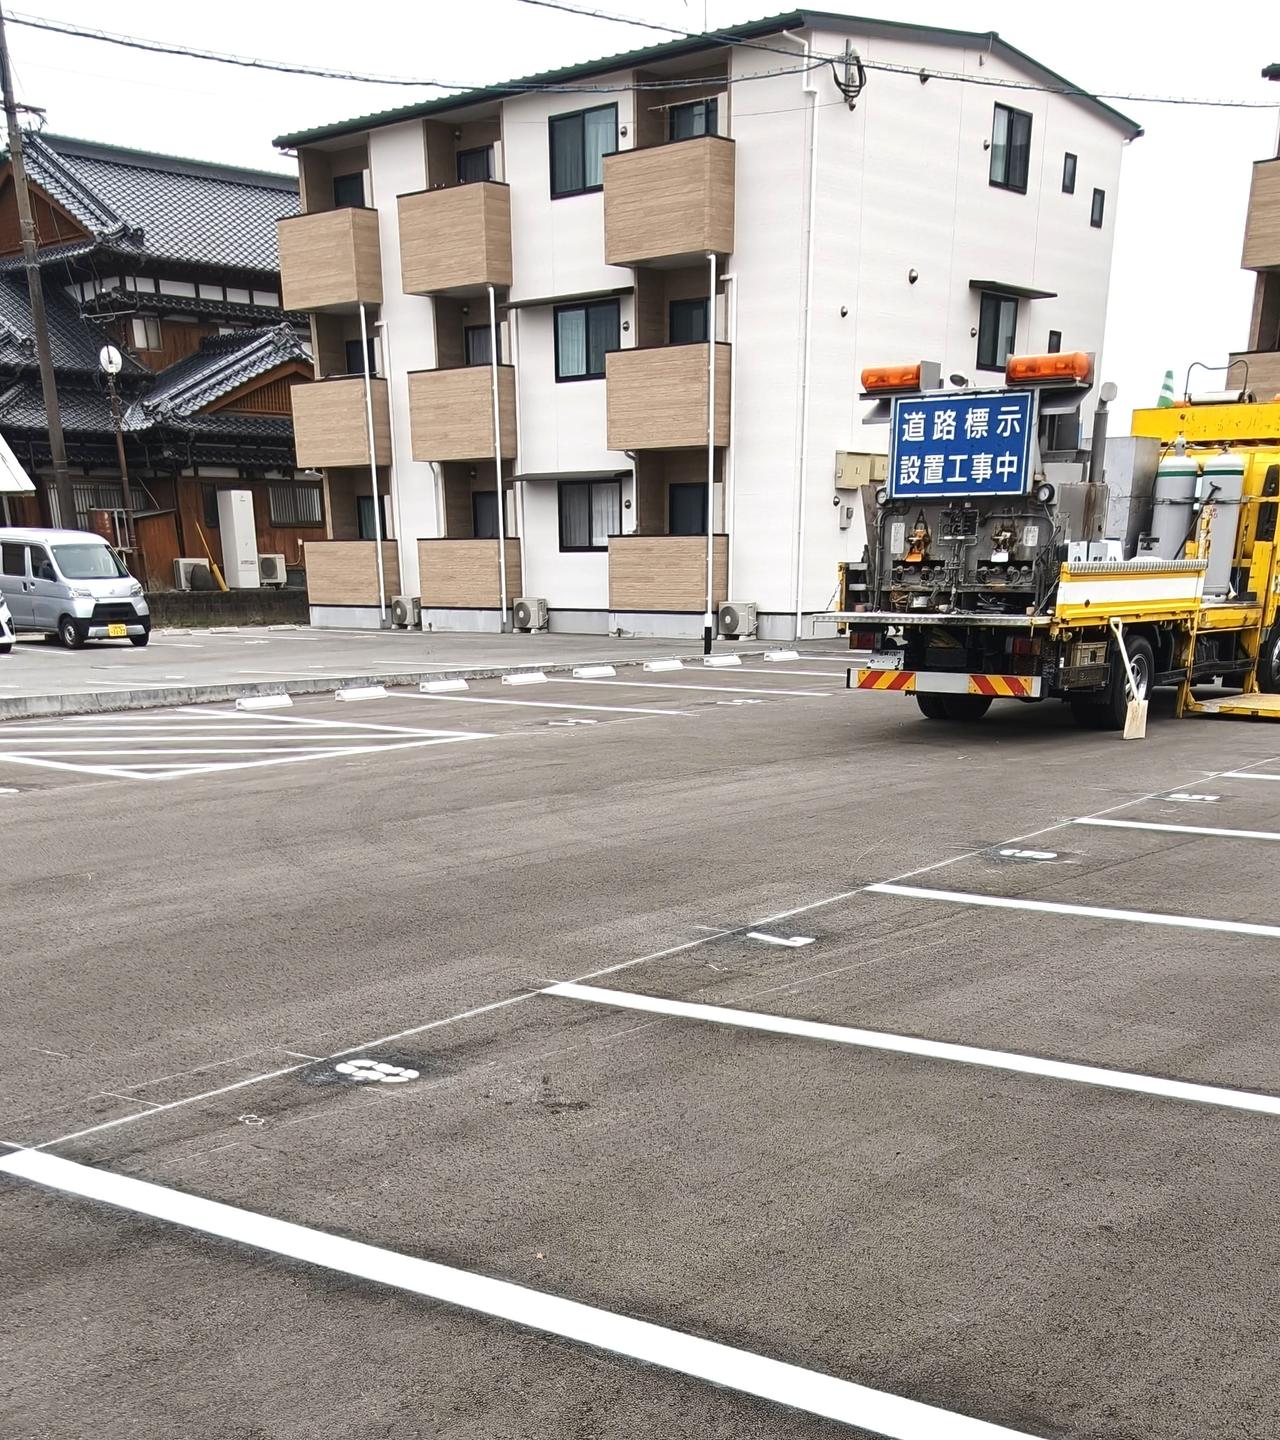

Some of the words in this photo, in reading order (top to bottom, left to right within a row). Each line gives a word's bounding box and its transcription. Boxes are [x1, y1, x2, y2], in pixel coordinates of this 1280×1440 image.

[902, 406, 1022, 441] 道路標示
[900, 451, 1018, 485] 設置工事中
